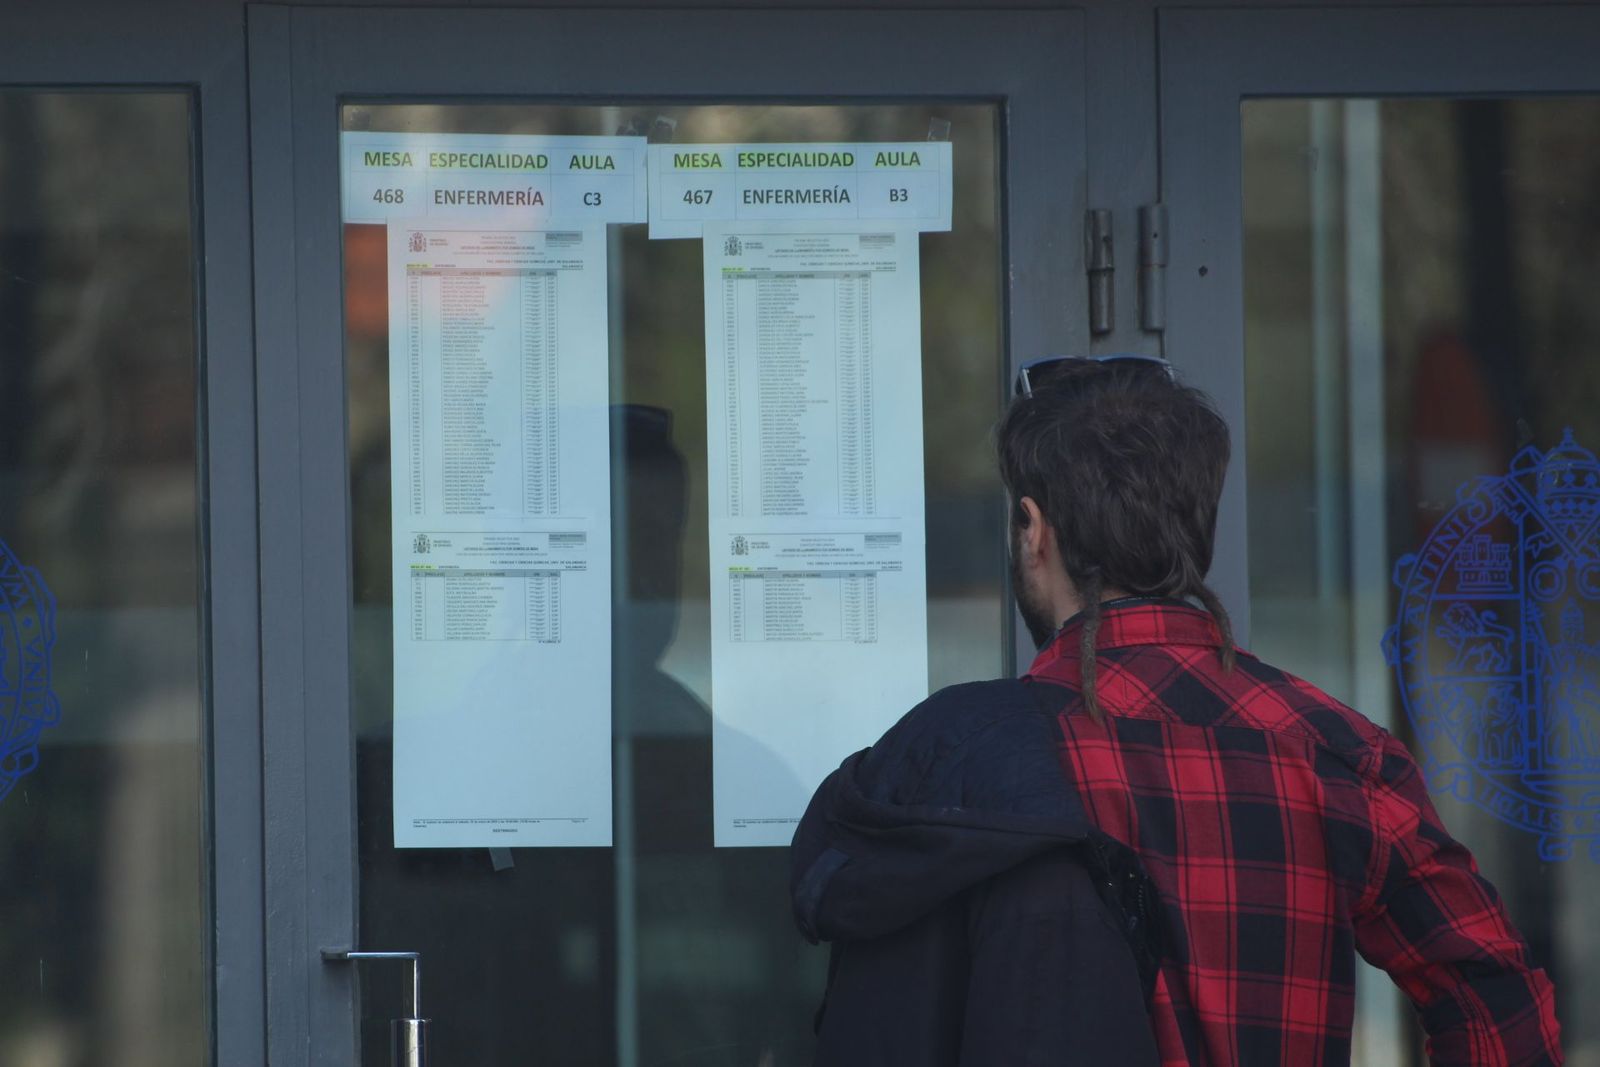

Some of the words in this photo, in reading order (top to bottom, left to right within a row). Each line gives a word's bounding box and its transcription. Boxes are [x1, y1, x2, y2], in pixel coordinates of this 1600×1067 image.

[364, 151, 413, 167] MESA
[429, 152, 548, 169] ESPECIALIDAD
[568, 154, 615, 170] AULA
[673, 152, 722, 168] MESA
[737, 152, 854, 168] ESPECIALIDAD
[875, 151, 921, 167] AULA
[373, 188, 404, 204] 468
[434, 186, 544, 206] ENFERMERÍA
[583, 192, 602, 206] C3
[683, 189, 713, 204] 467
[743, 185, 851, 204] ENFERMERÍA
[889, 188, 909, 203] B3
